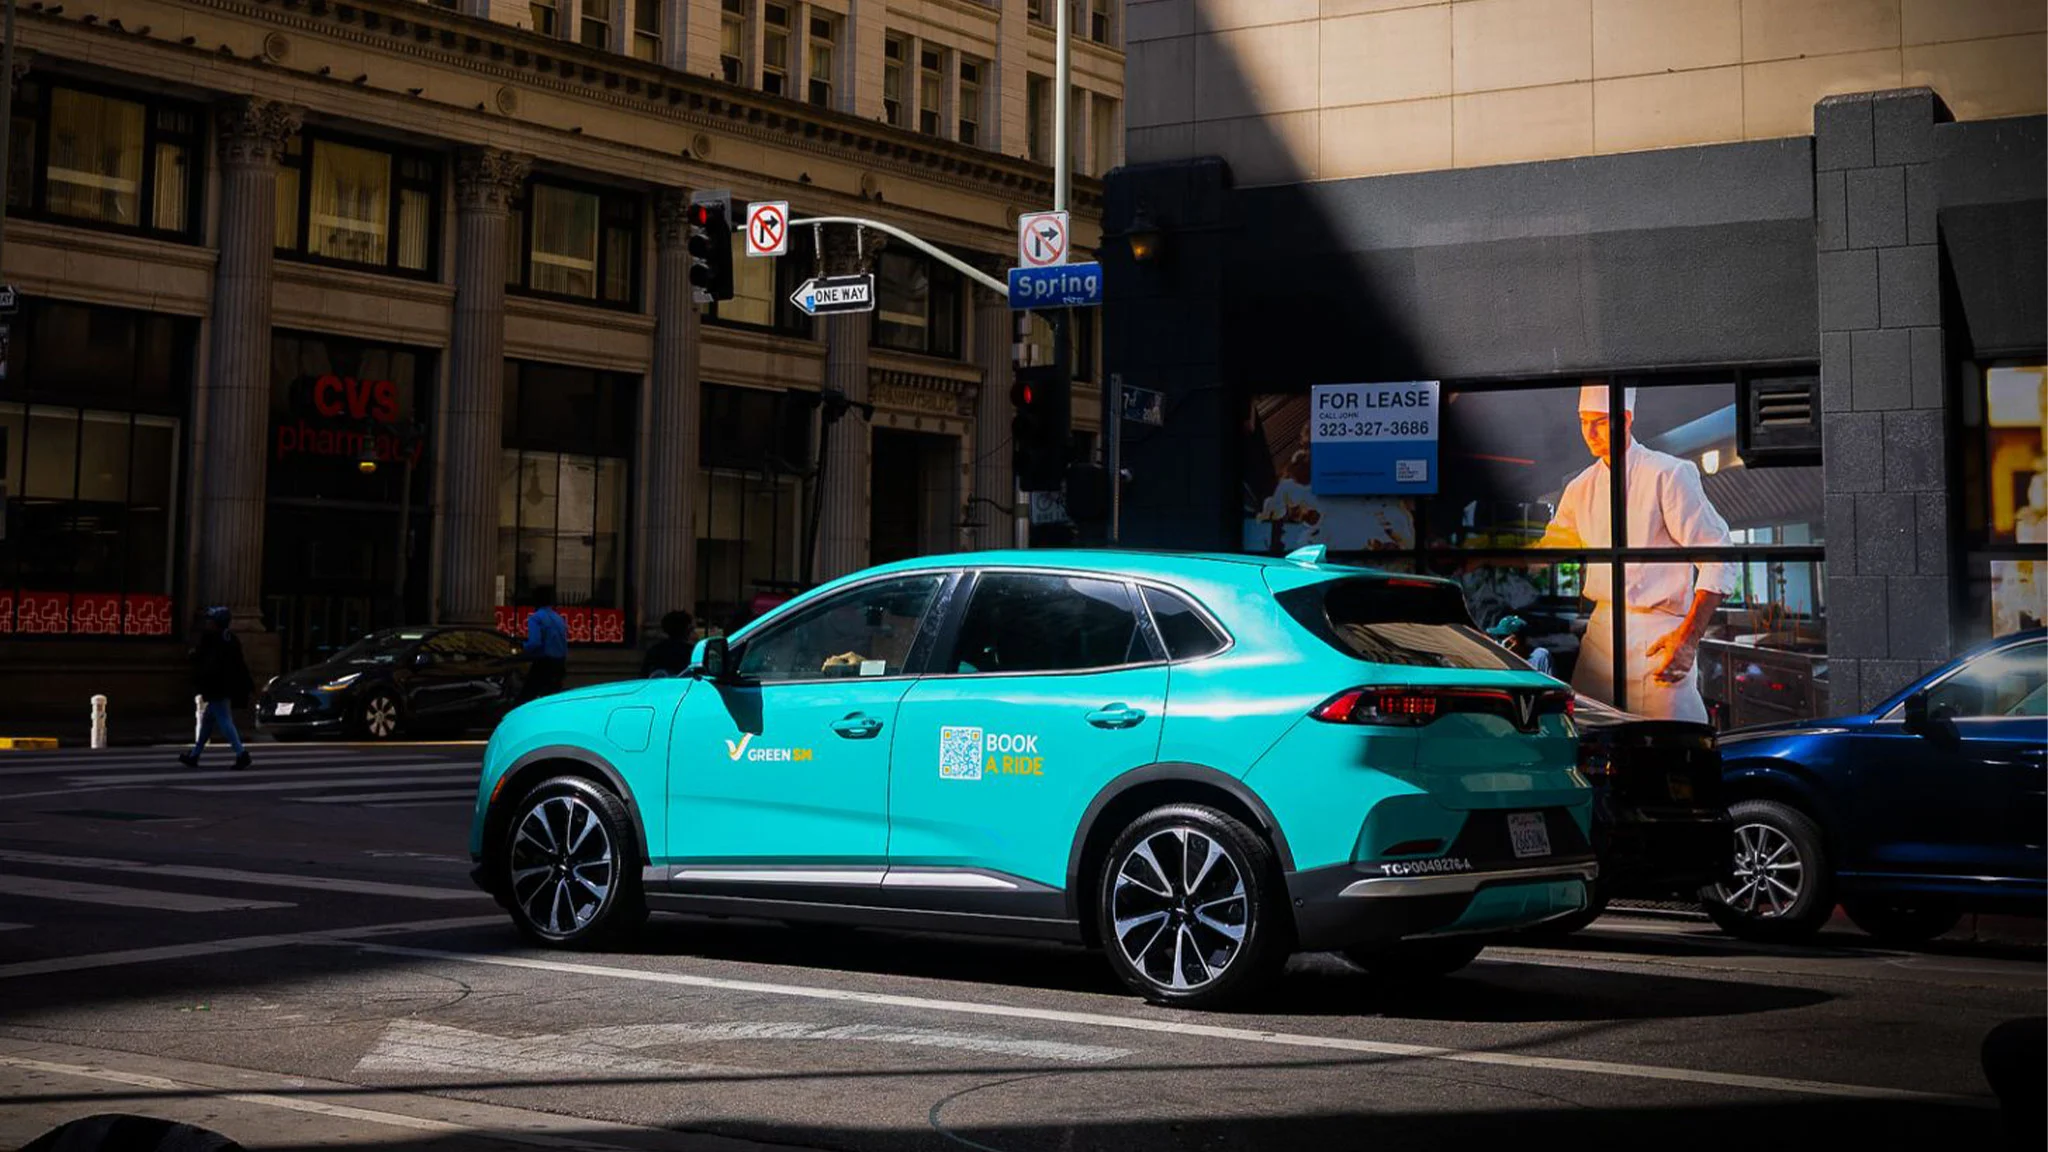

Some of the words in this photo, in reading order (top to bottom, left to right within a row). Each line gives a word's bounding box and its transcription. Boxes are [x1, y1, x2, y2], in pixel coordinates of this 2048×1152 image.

[815, 288, 839, 302] ONE
[842, 287, 865, 301] WAY
[1018, 273, 1097, 300] Spring
[314, 375, 399, 424] CVS
[1319, 393, 1358, 409] FOR
[1366, 391, 1429, 408] LEASE
[1319, 412, 1337, 420] CALL
[1340, 411, 1358, 419] JOHN
[1319, 421, 1429, 437] 323-327-3686
[986, 734, 1038, 753] BOOK
[748, 748, 791, 761] GREEN
[793, 749, 813, 761] SM
[984, 755, 999, 774] A
[1002, 755, 1044, 775] RIDE
